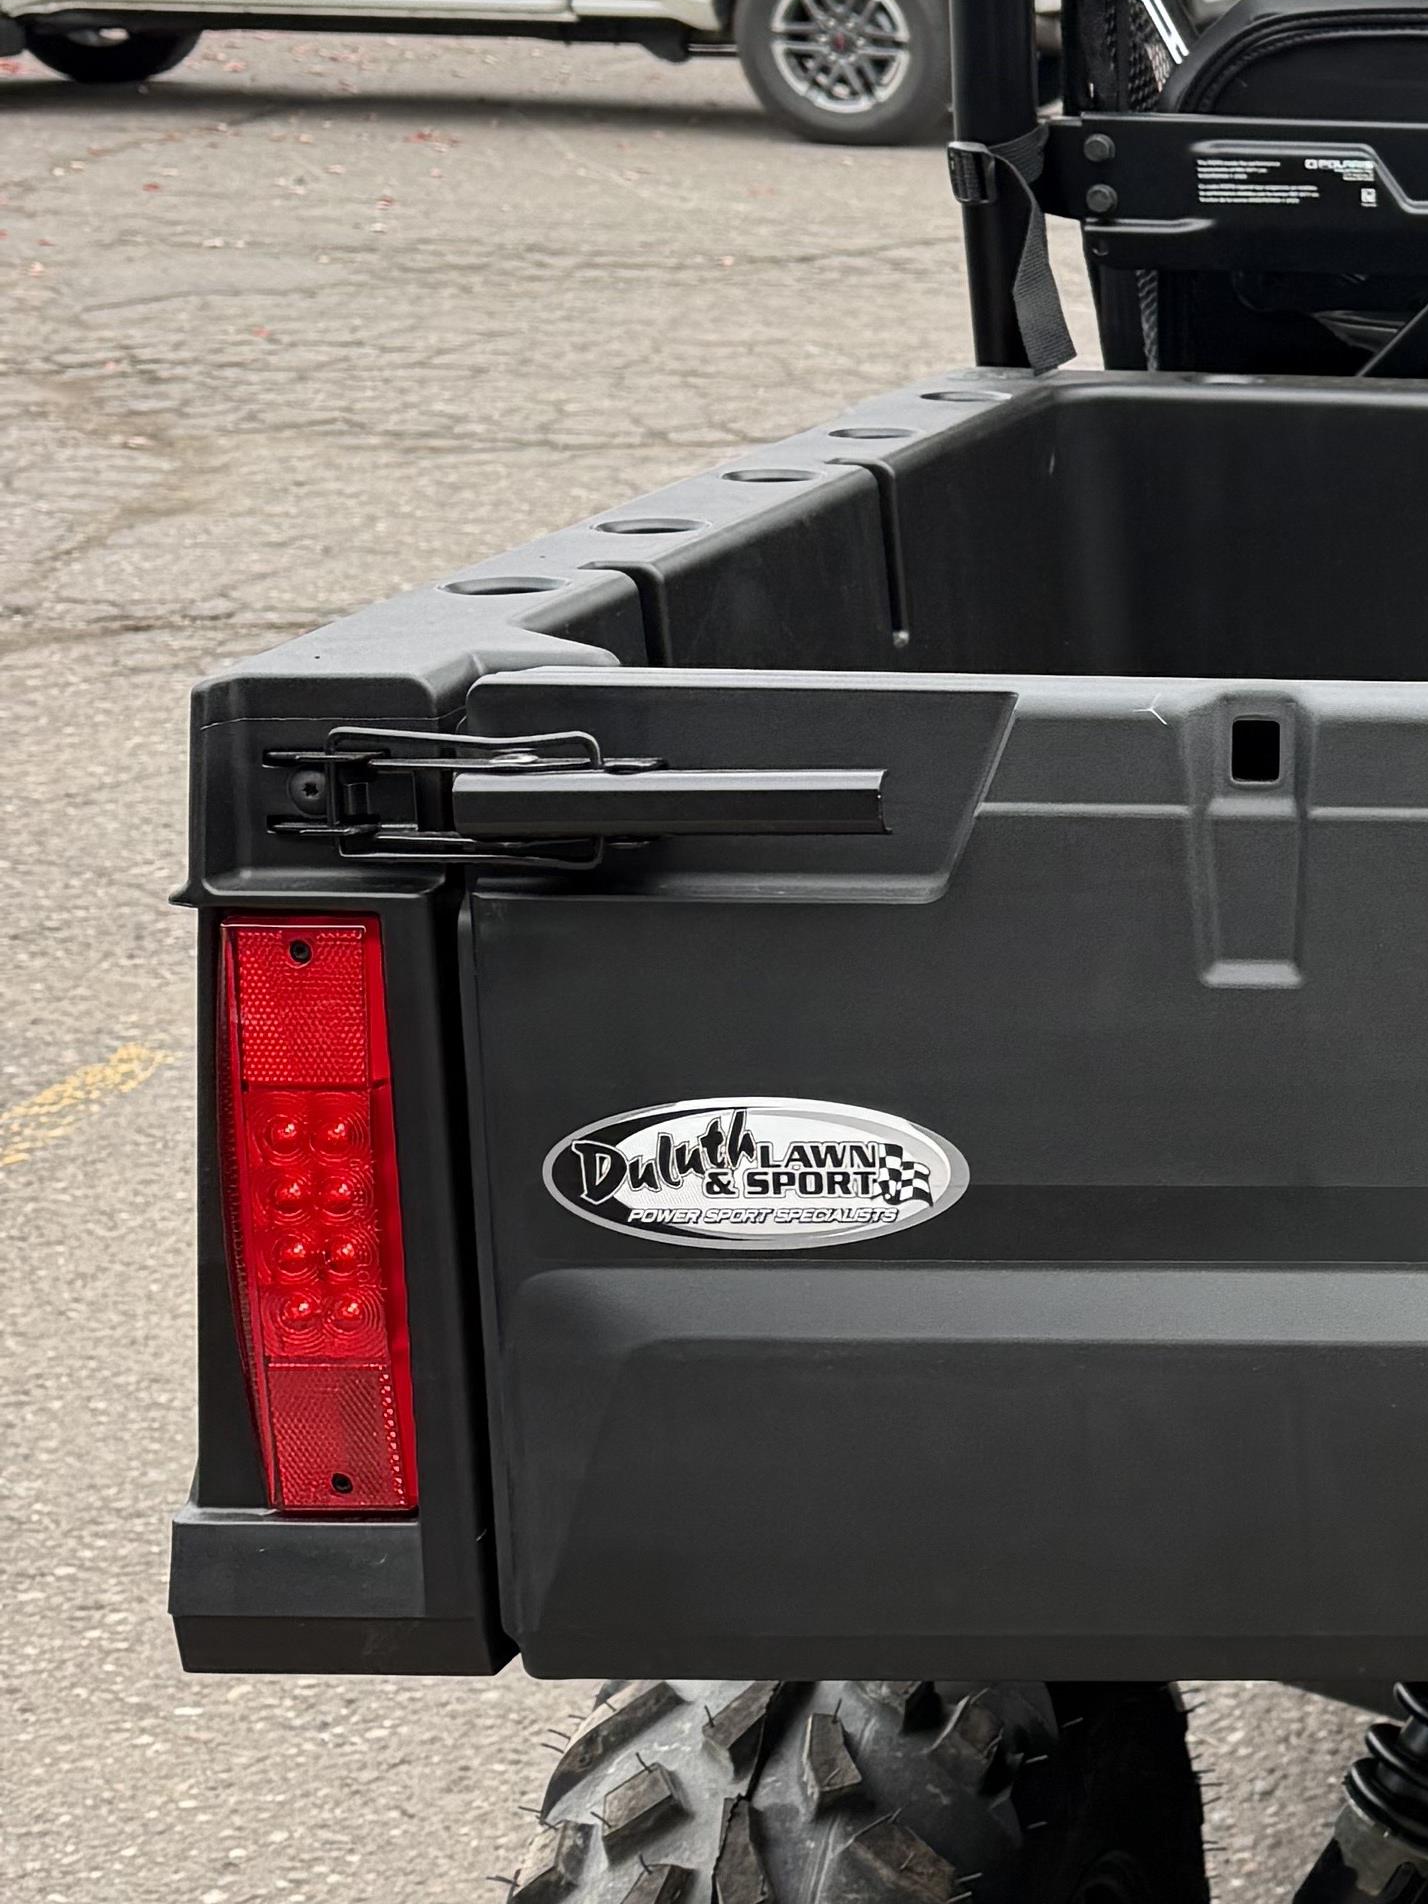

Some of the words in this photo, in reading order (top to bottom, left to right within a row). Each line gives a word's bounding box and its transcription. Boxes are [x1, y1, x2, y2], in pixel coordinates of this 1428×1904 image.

[572, 1108, 756, 1205] Duluth
[759, 1142, 877, 1169] LAWN
[705, 1172, 738, 1196] &
[747, 1172, 878, 1196] SPORT
[628, 1208, 702, 1223] POWER
[703, 1208, 772, 1223] SPORT
[775, 1208, 899, 1223] SPECIALISTS
